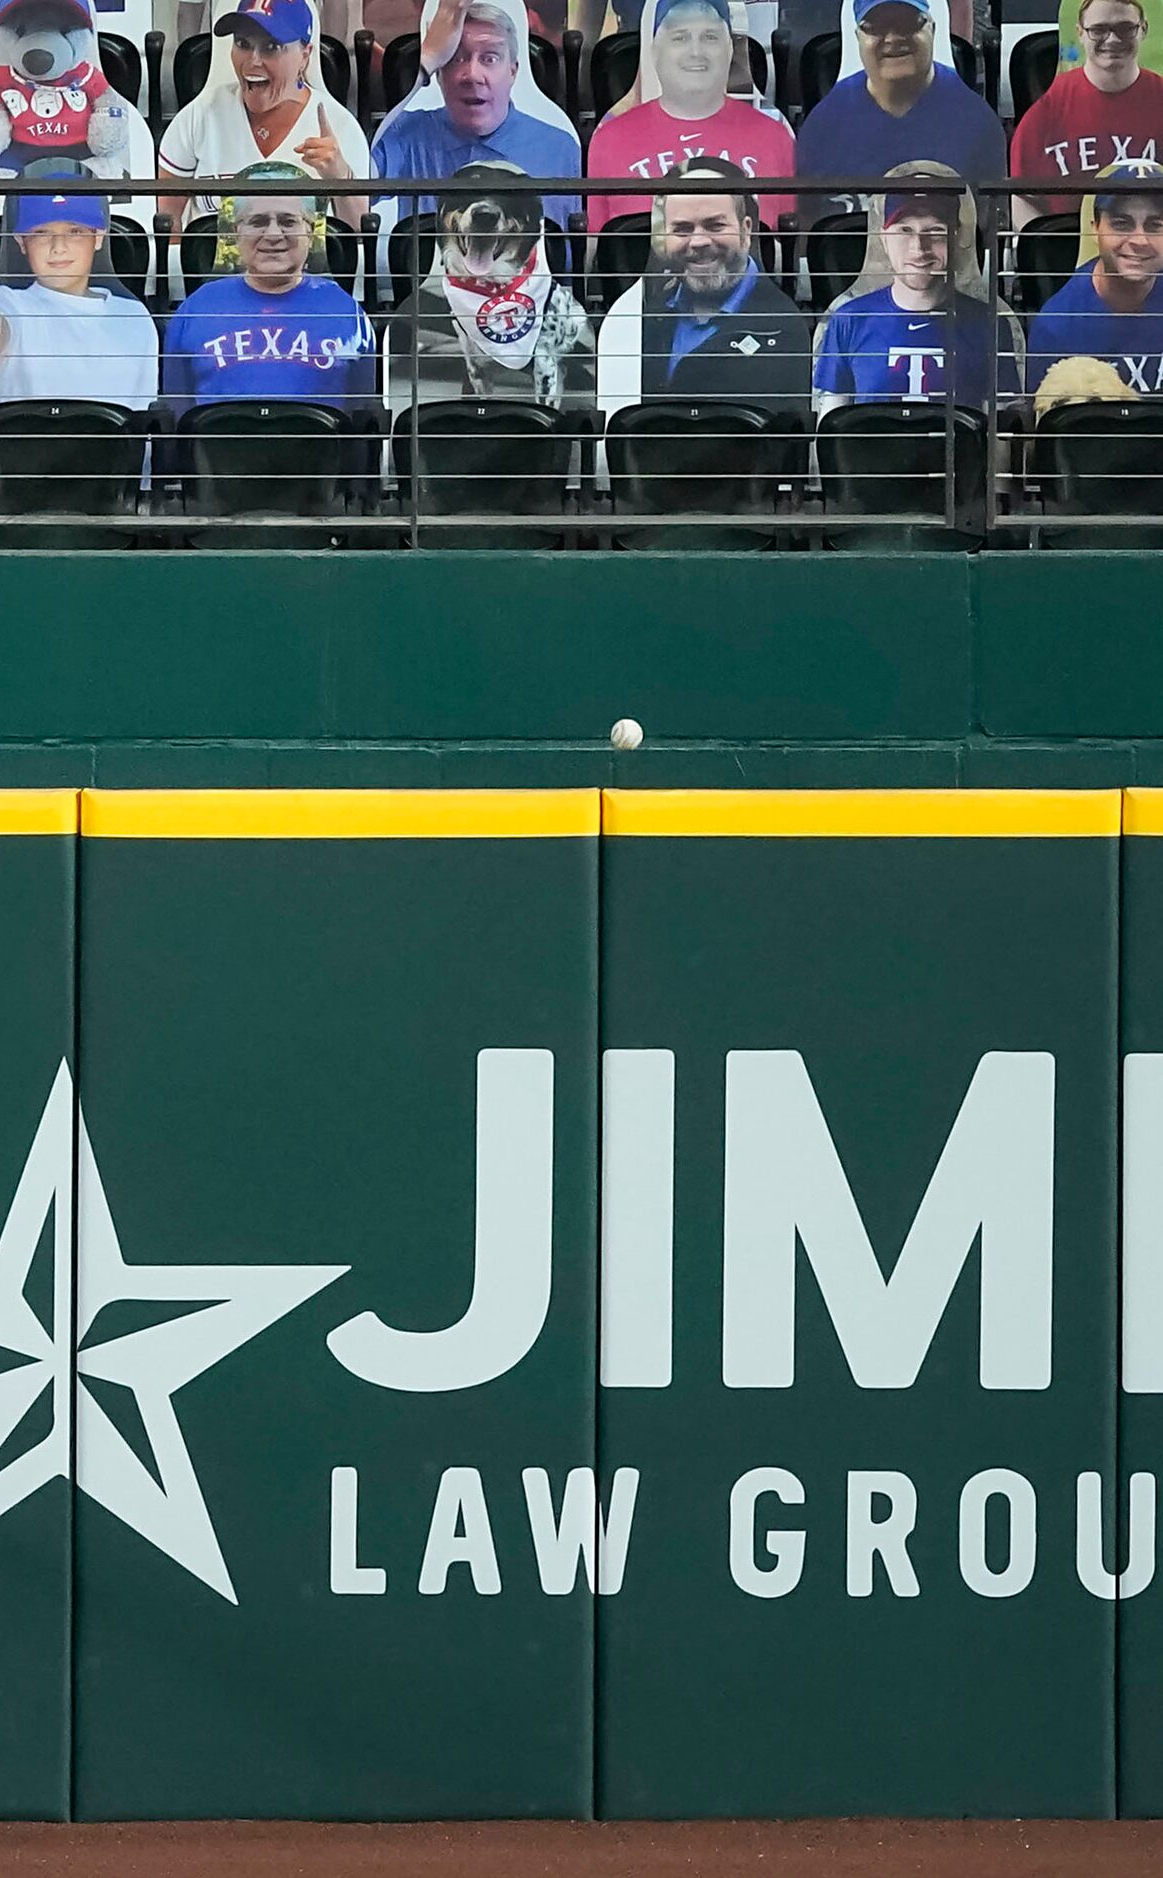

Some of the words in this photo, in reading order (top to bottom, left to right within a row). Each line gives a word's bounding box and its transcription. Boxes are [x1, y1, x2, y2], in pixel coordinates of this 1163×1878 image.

[27, 122, 69, 137] TEXAS
[203, 328, 339, 370] TEXAS
[887, 346, 945, 402] T
[326, 1048, 1056, 1392] JIM
[330, 1467, 640, 1596] LAW
[729, 1468, 1157, 1600] GROU
